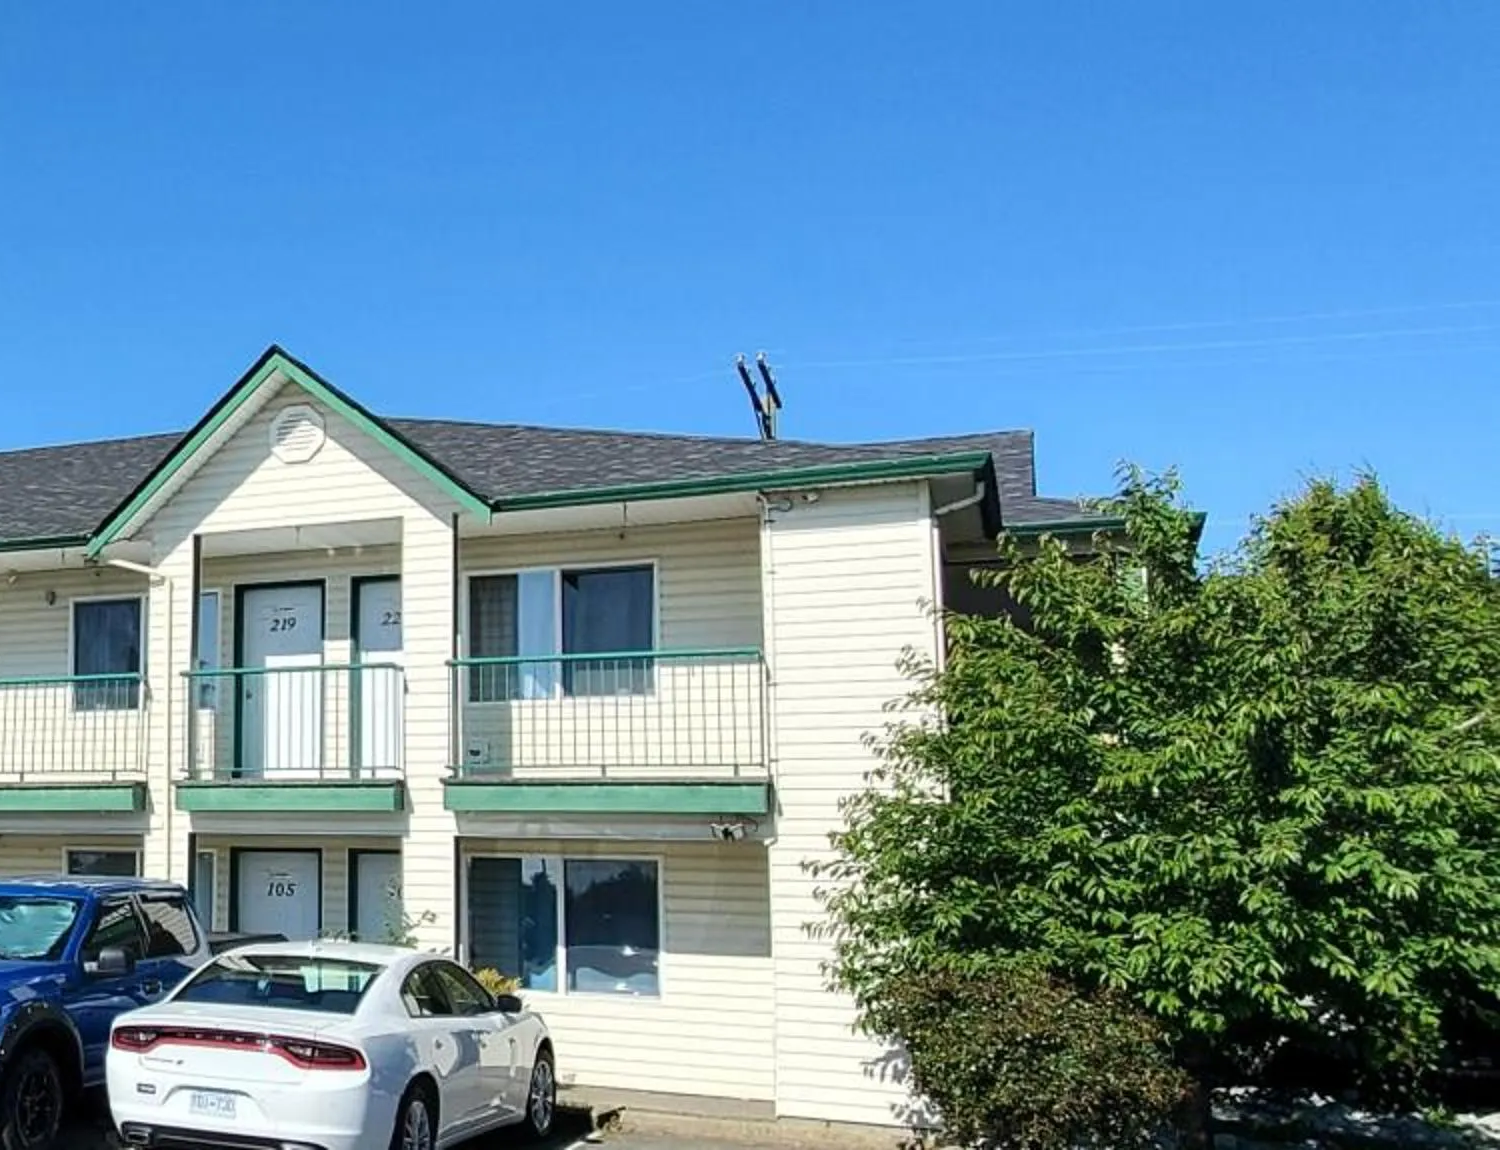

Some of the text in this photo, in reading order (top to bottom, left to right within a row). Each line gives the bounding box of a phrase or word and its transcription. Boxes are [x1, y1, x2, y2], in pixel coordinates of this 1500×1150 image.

[270, 617, 297, 632] 219
[381, 612, 402, 626] 22
[267, 881, 297, 898] 105
